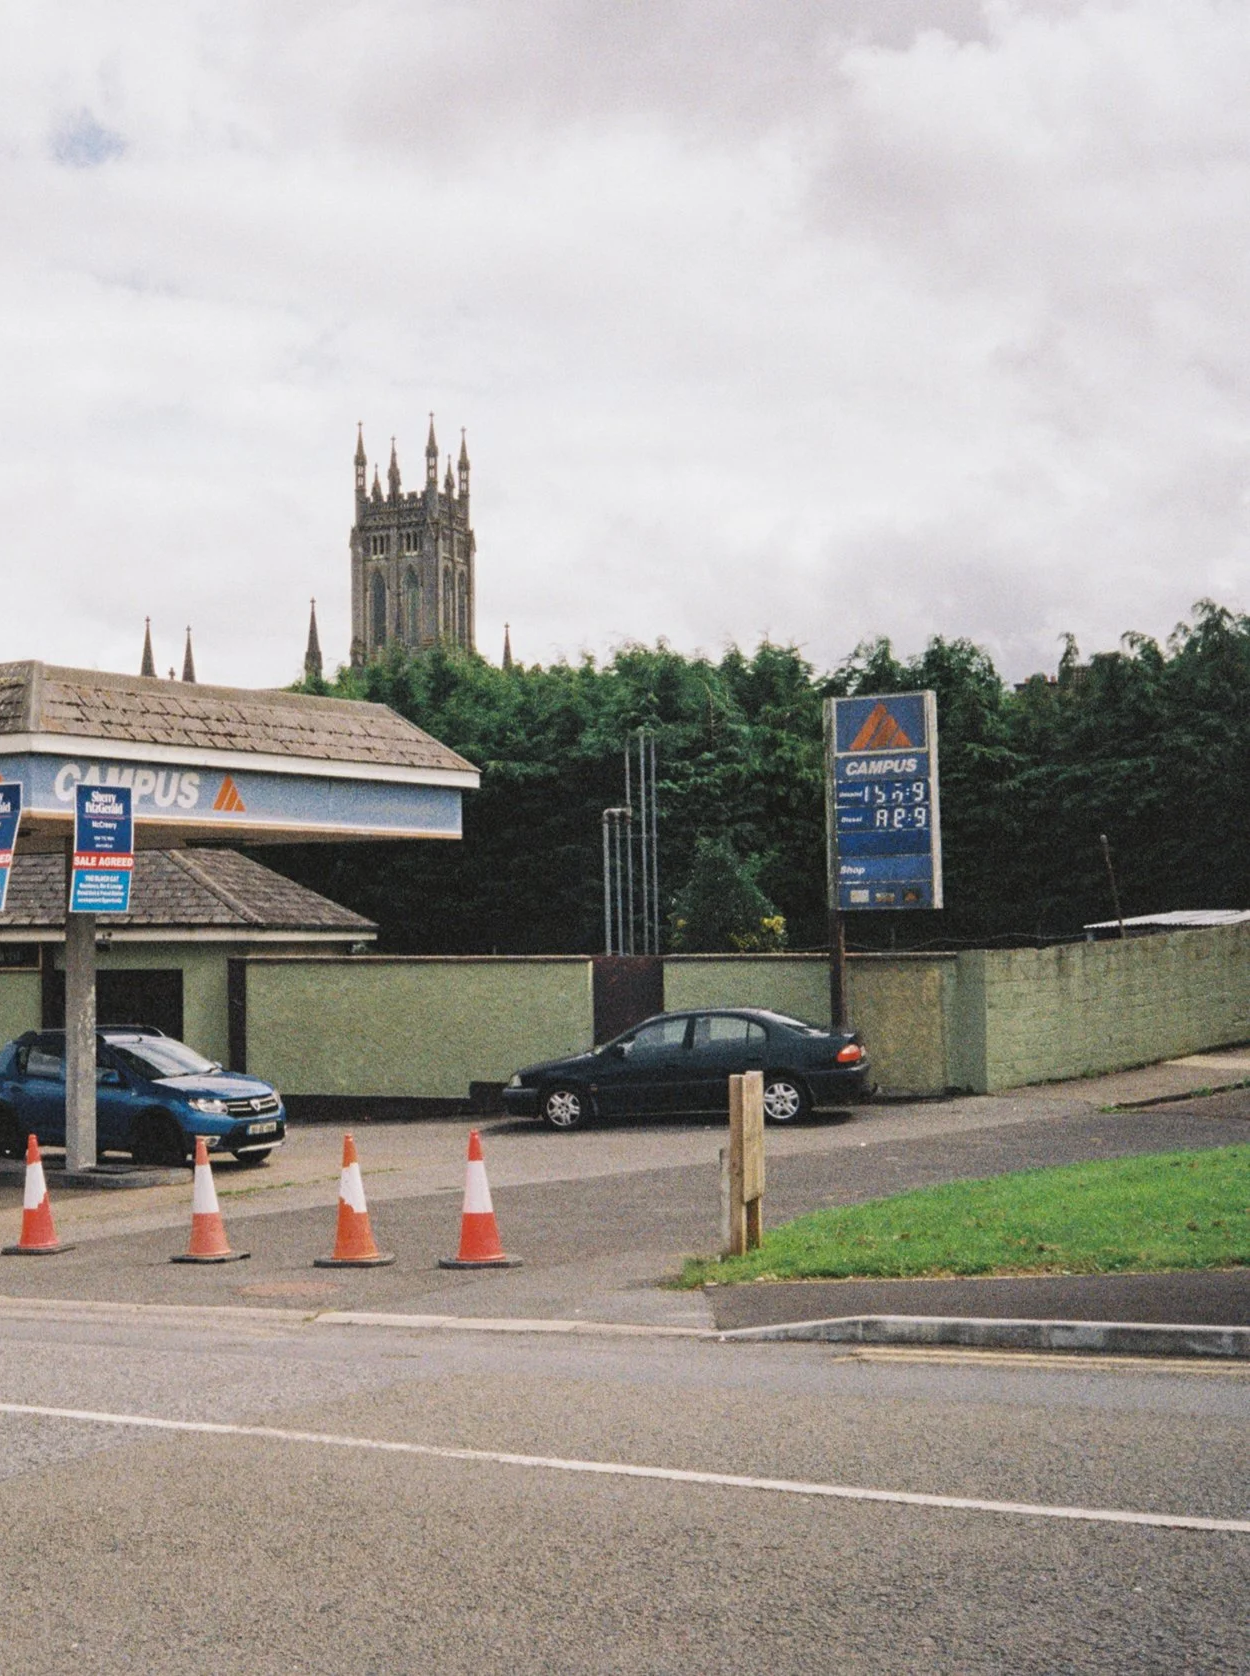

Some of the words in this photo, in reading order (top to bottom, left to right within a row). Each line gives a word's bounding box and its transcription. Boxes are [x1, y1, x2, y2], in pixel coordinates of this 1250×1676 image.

[845, 758, 918, 776] CAMPUS
[91, 791, 117, 804] Sherry
[74, 856, 97, 866] SALE
[98, 856, 134, 867] AGREED
[840, 865, 865, 875] Shop
